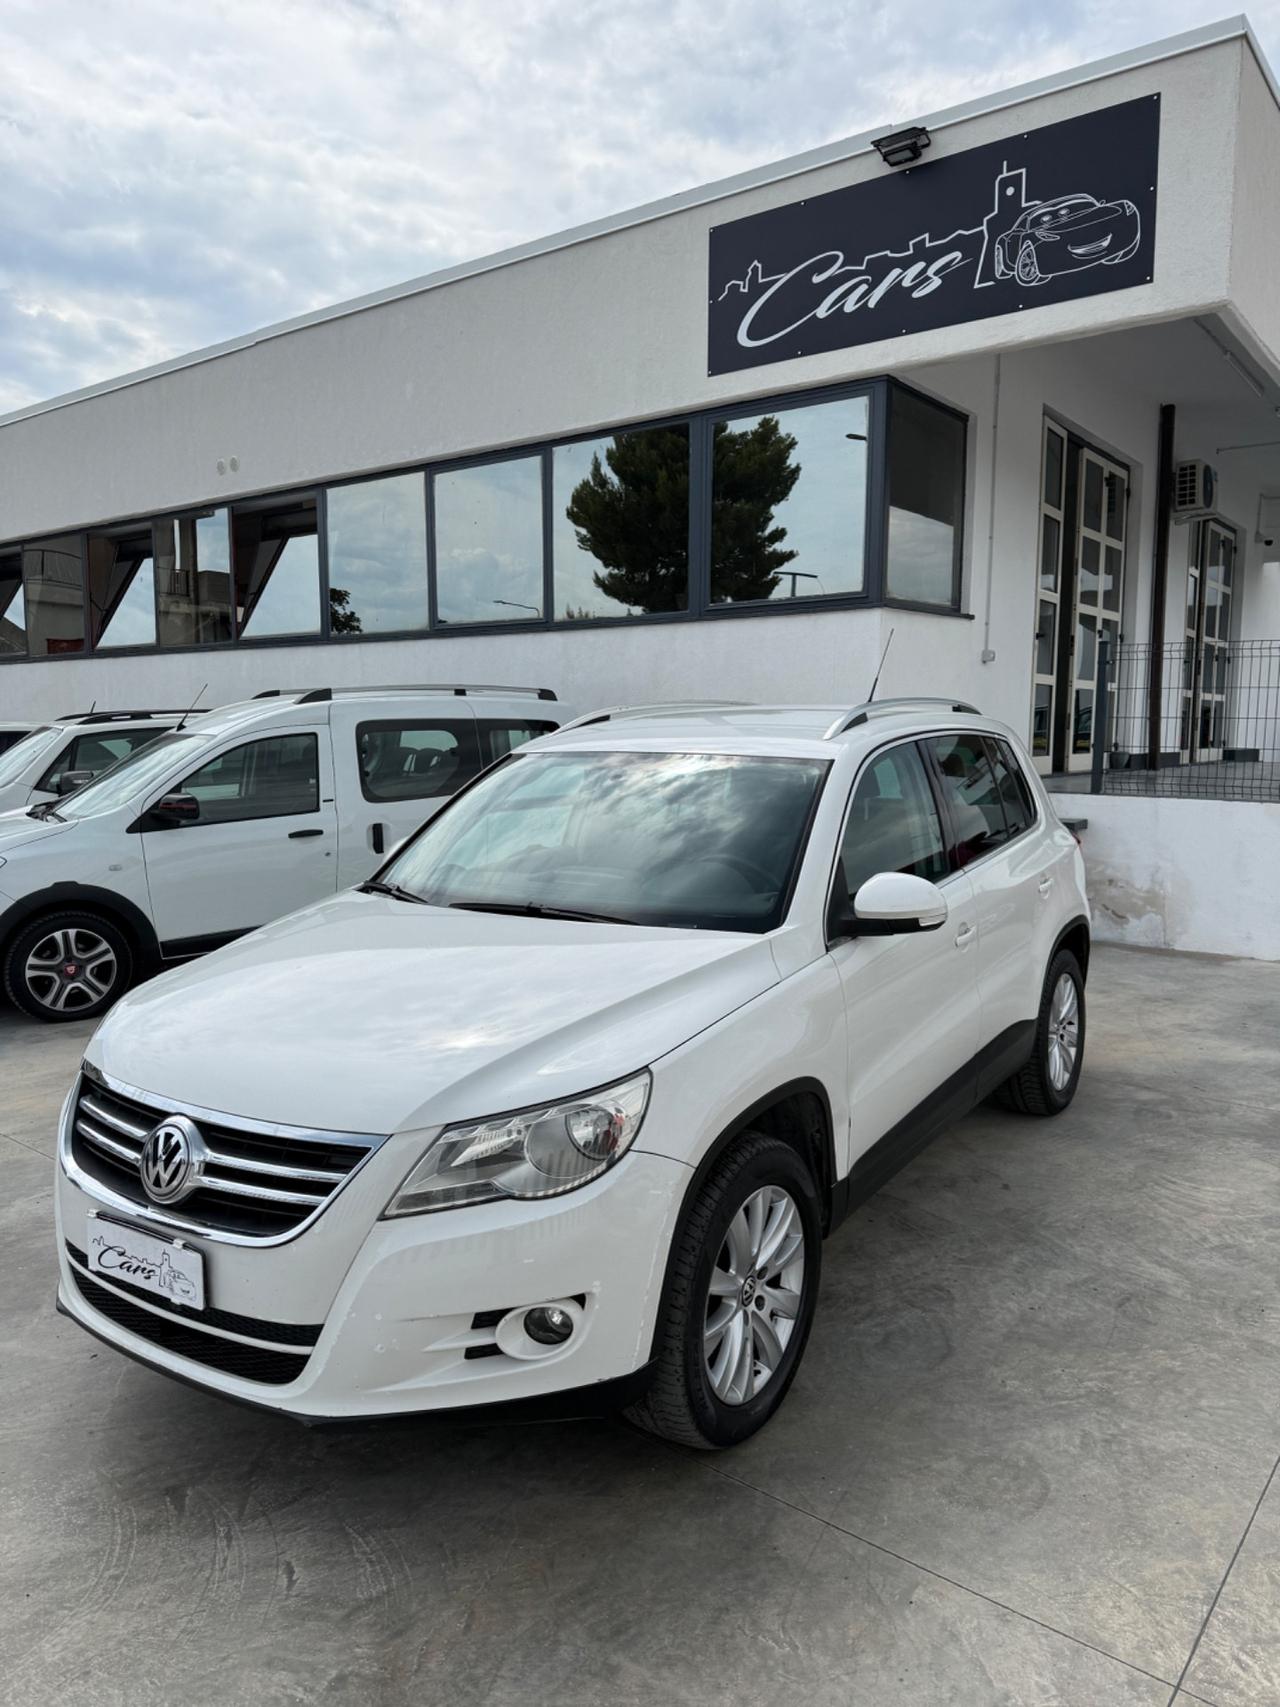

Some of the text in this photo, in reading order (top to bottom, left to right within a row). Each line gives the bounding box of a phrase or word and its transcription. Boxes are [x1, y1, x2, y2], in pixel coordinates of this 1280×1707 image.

[737, 250, 972, 348] Cars
[145, 1127, 188, 1196] VW
[98, 1245, 158, 1280] Cars
